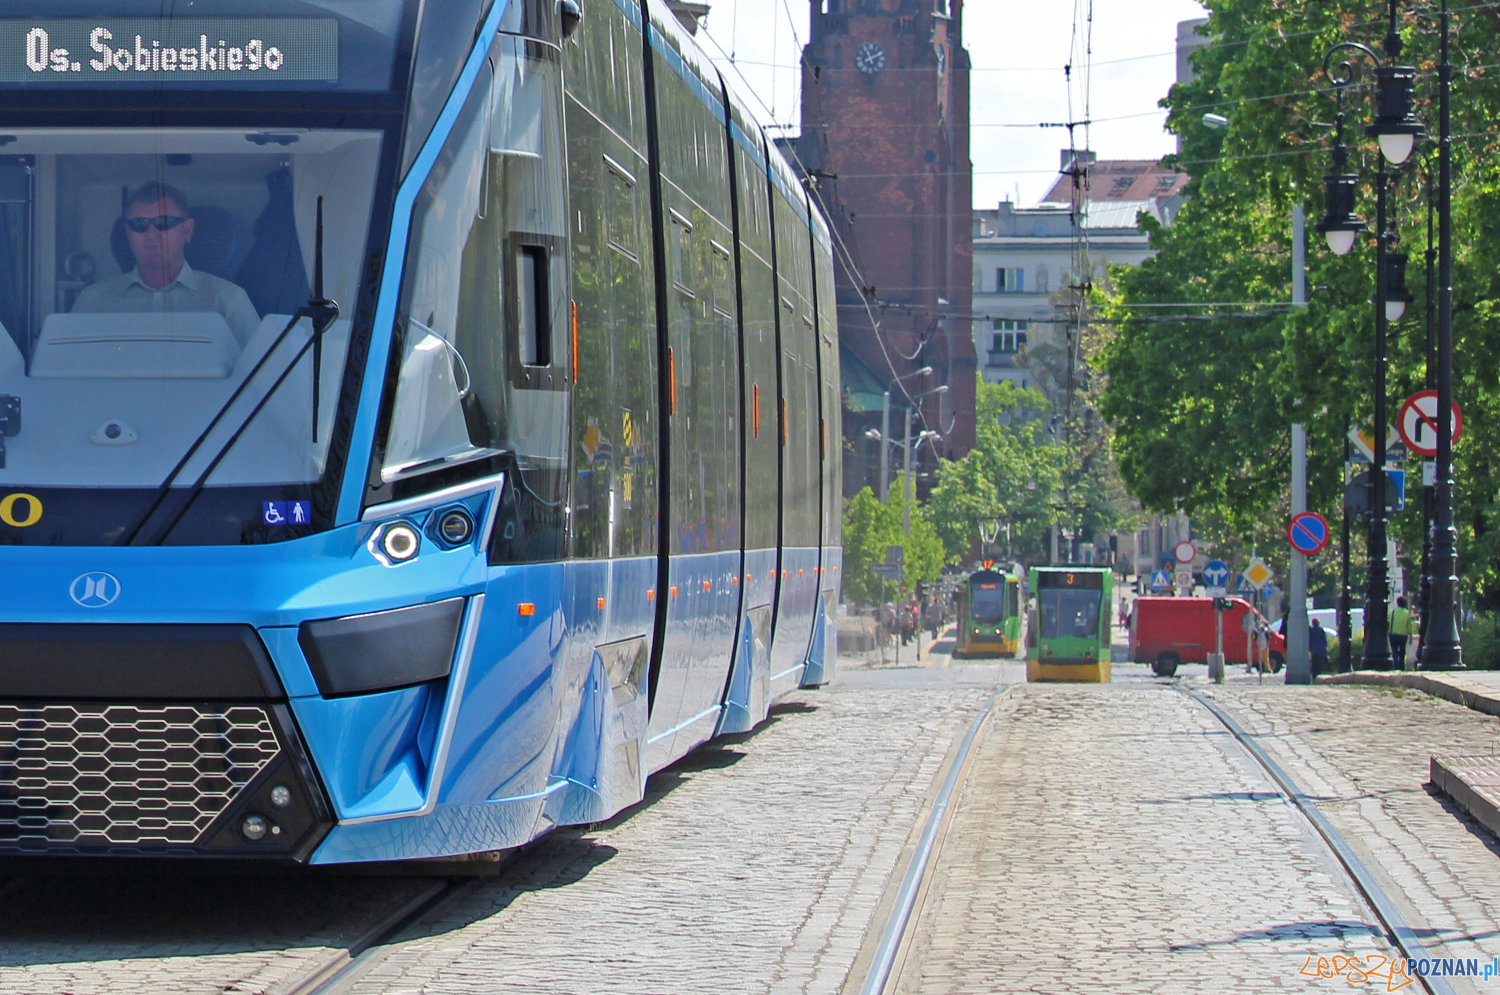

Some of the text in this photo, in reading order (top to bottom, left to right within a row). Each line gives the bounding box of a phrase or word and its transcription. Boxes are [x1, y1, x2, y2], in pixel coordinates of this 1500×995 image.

[26, 27, 81, 73] Os.
[89, 26, 284, 73] Sobieskiego
[1067, 573, 1075, 585] 3
